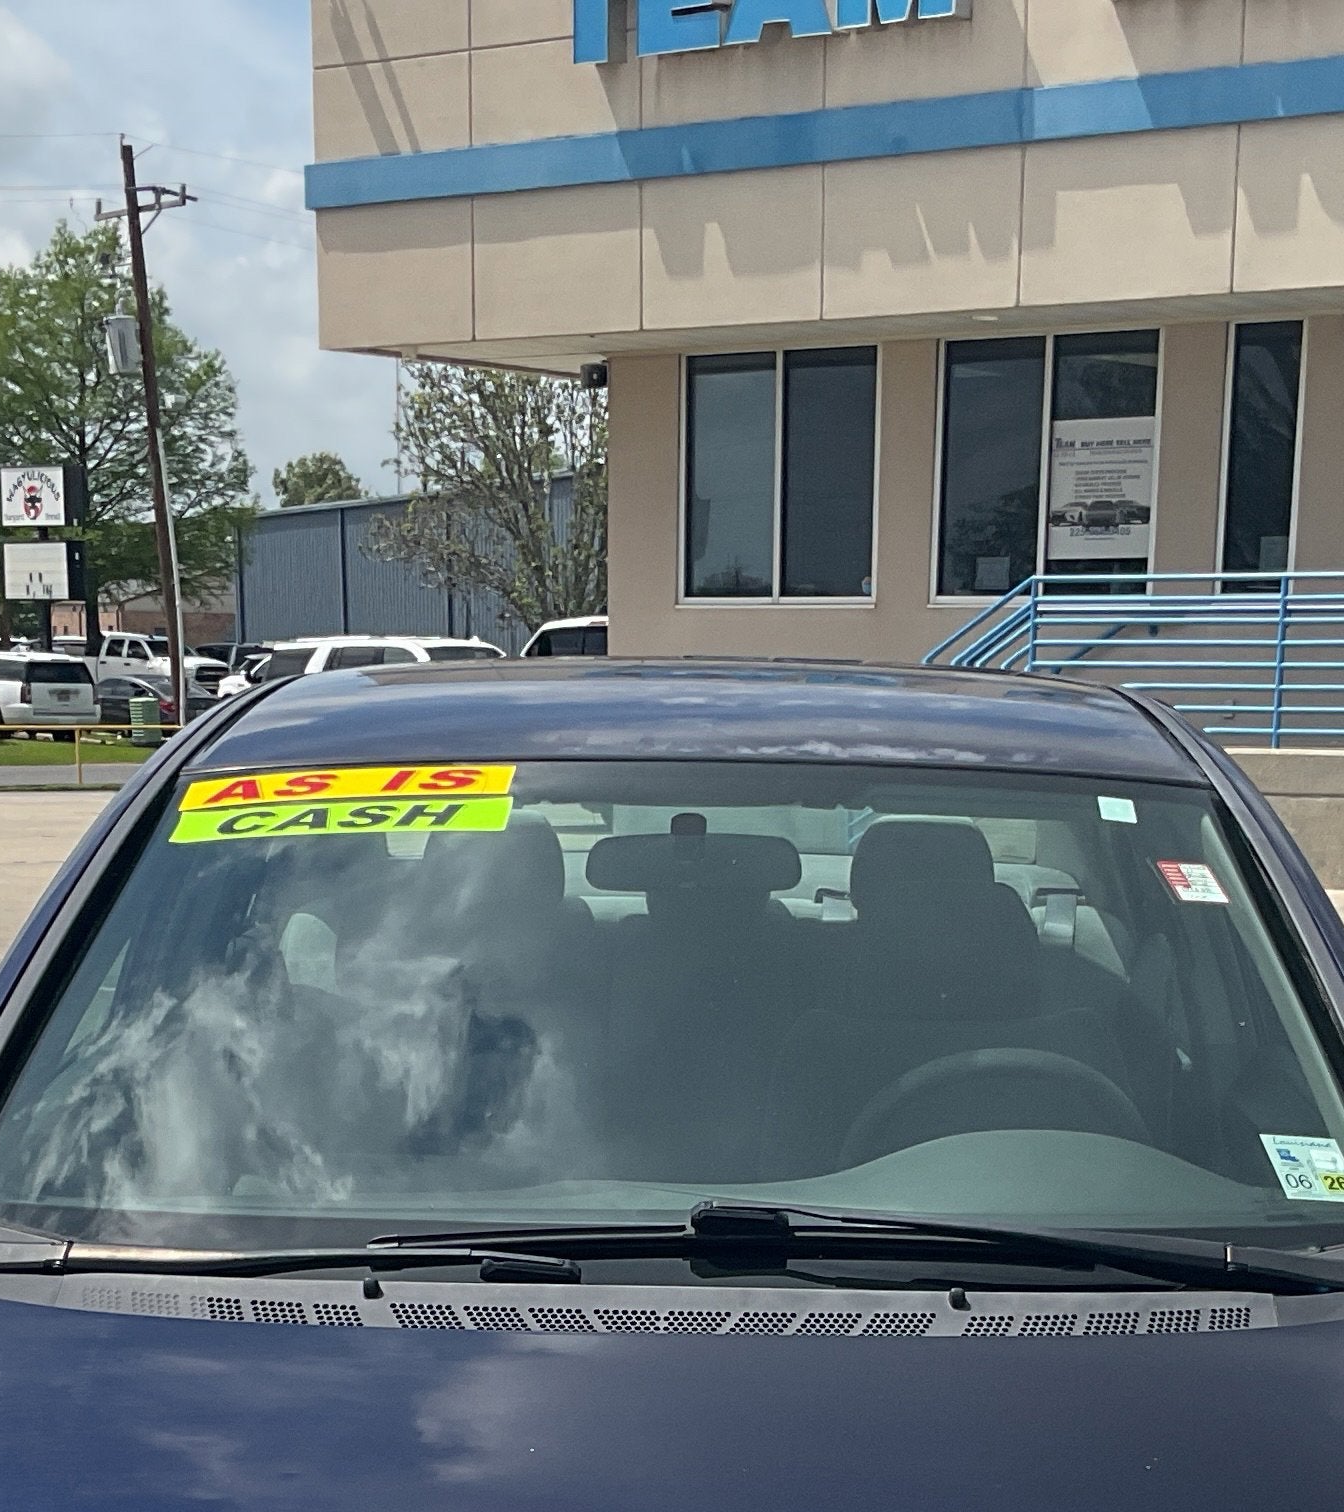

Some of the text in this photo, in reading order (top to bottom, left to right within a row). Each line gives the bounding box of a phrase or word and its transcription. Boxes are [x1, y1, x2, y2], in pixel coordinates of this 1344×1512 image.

[204, 769, 486, 805] AS IS
[216, 804, 468, 835] CASH
[1285, 1173, 1312, 1190] 06
